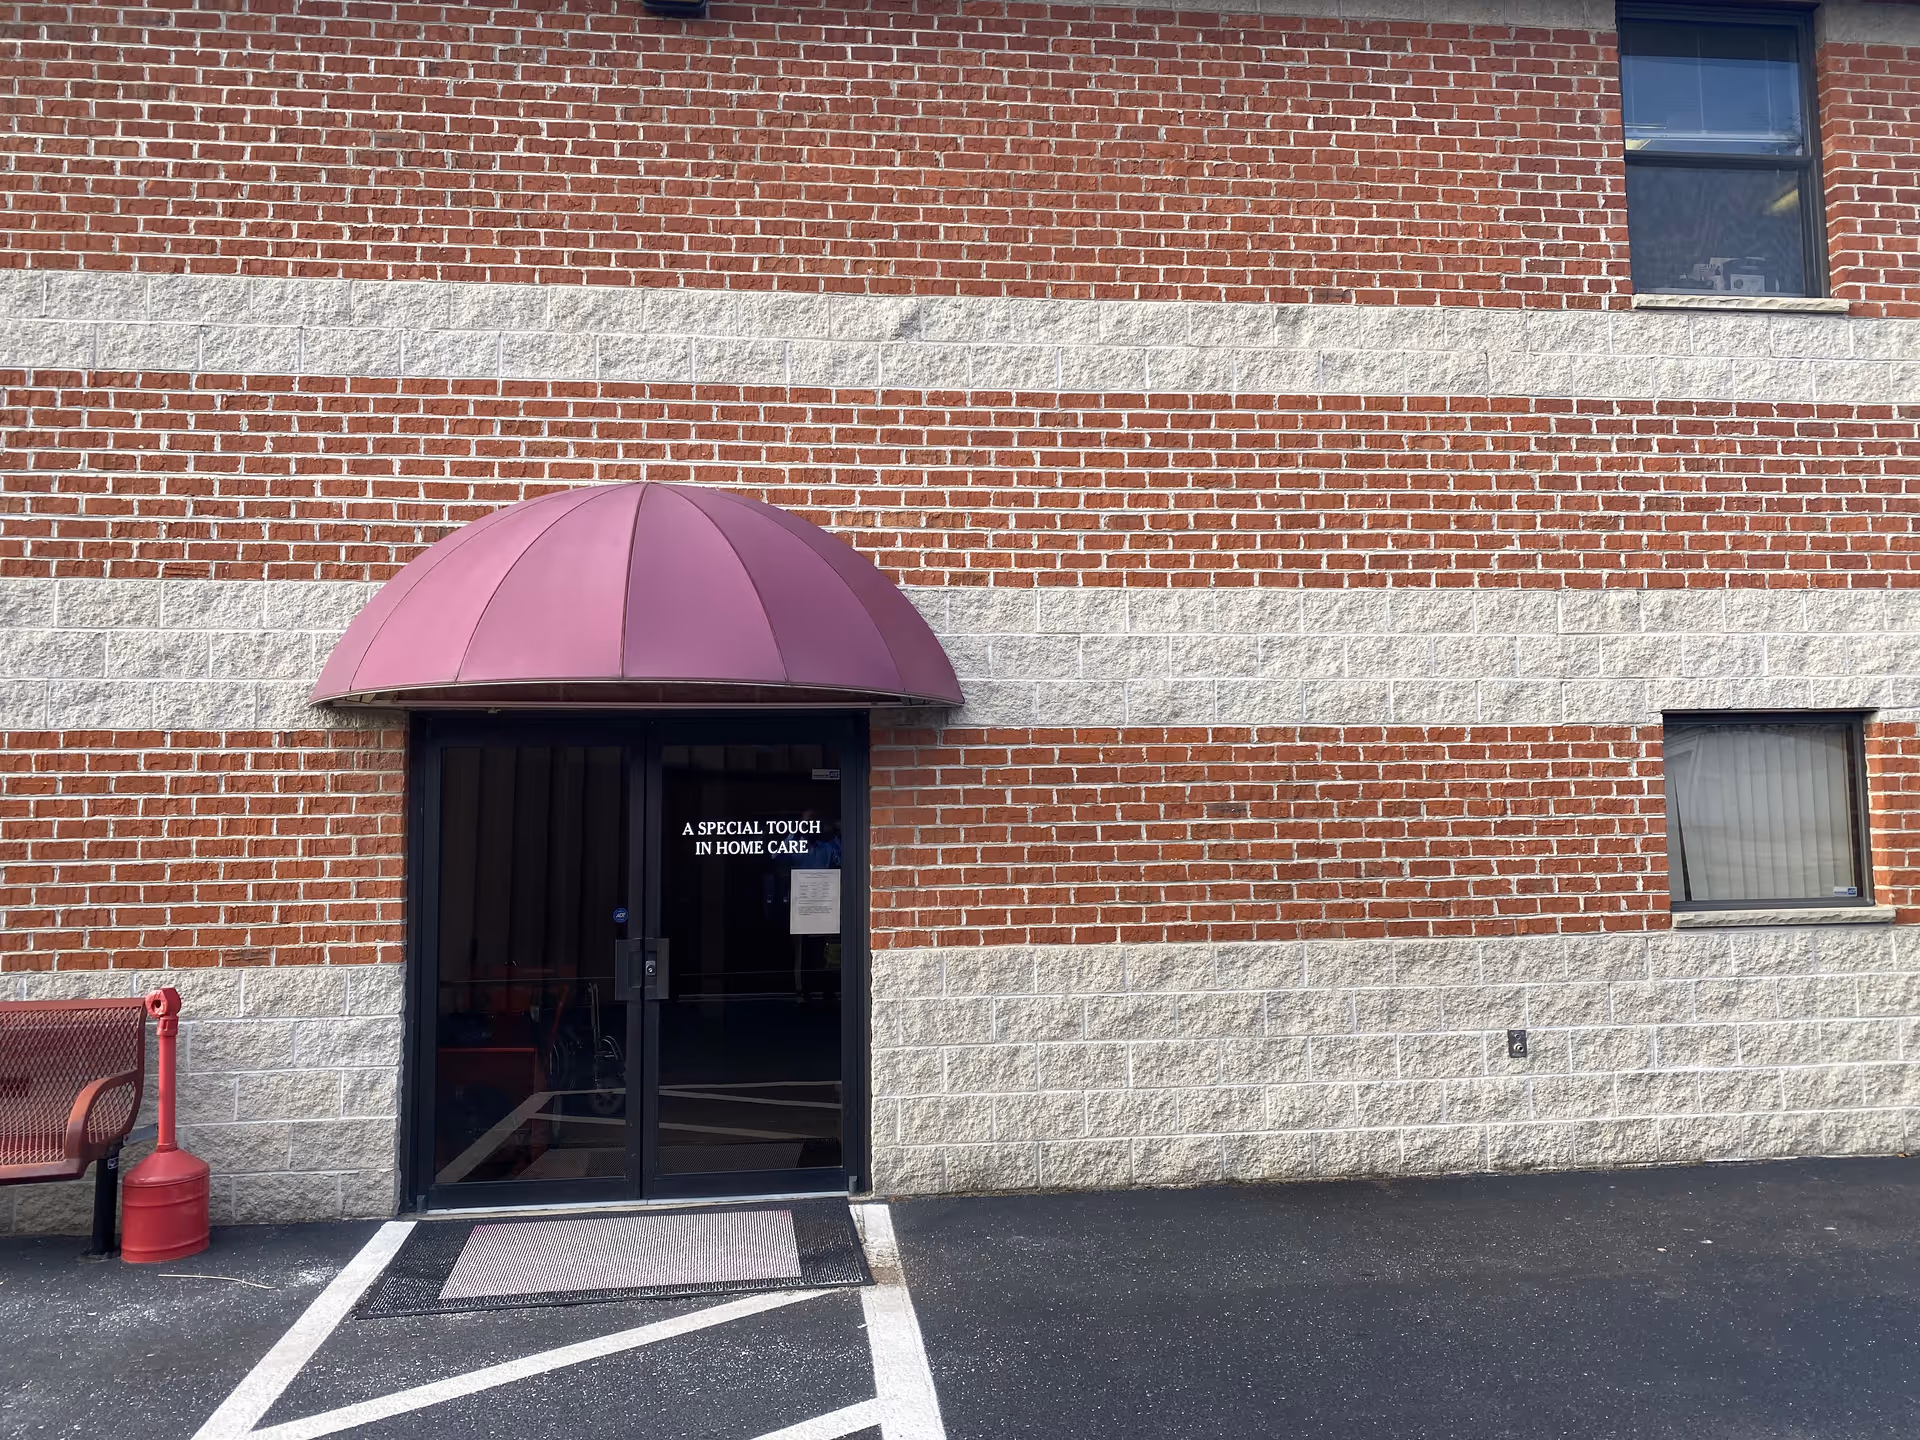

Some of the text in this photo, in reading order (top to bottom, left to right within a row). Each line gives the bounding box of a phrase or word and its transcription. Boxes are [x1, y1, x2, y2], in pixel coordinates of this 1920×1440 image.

[682, 820, 821, 836] A SPECIAL TOUCH
[695, 840, 809, 856] IN HOME CARE
